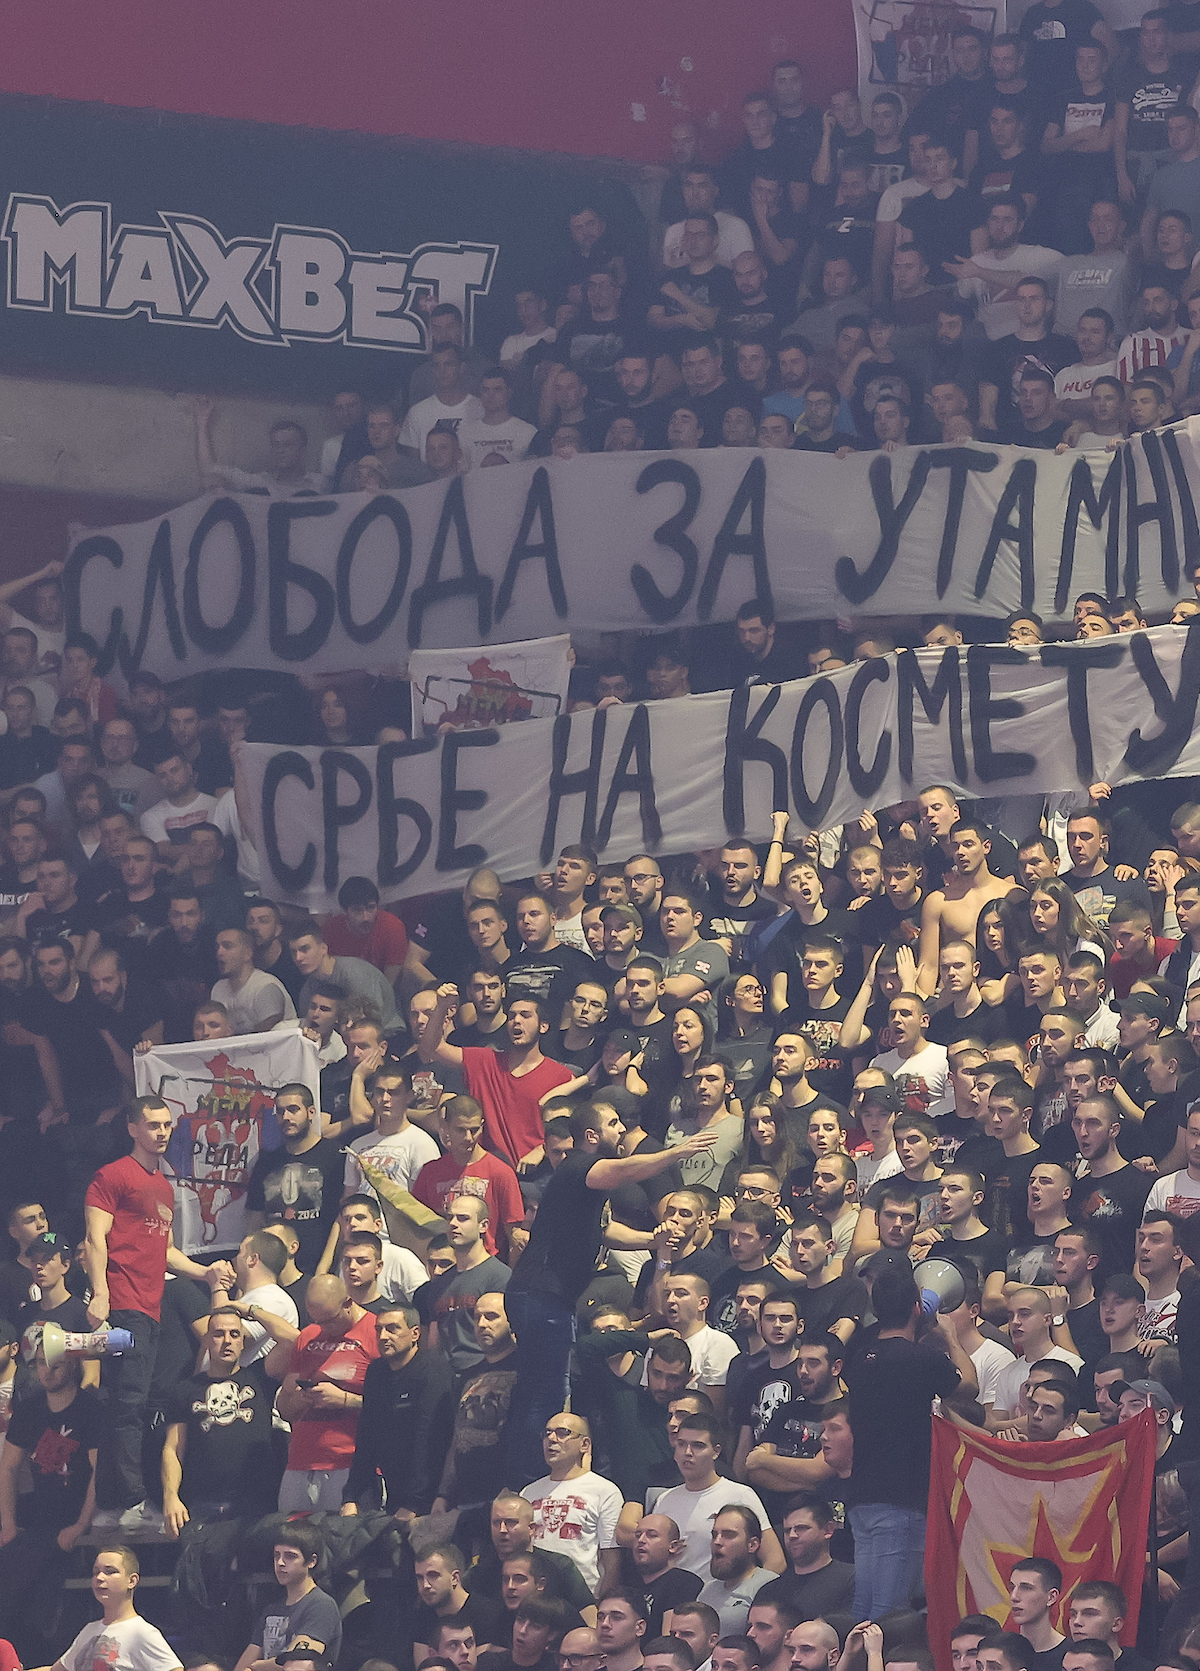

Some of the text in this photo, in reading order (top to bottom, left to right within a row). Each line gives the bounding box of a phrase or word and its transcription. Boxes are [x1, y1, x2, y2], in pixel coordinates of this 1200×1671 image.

[64, 466, 568, 680] СЛОБОДА
[631, 455, 774, 626] ЗА
[261, 727, 501, 893] СРБЕ
[540, 703, 663, 868] НА
